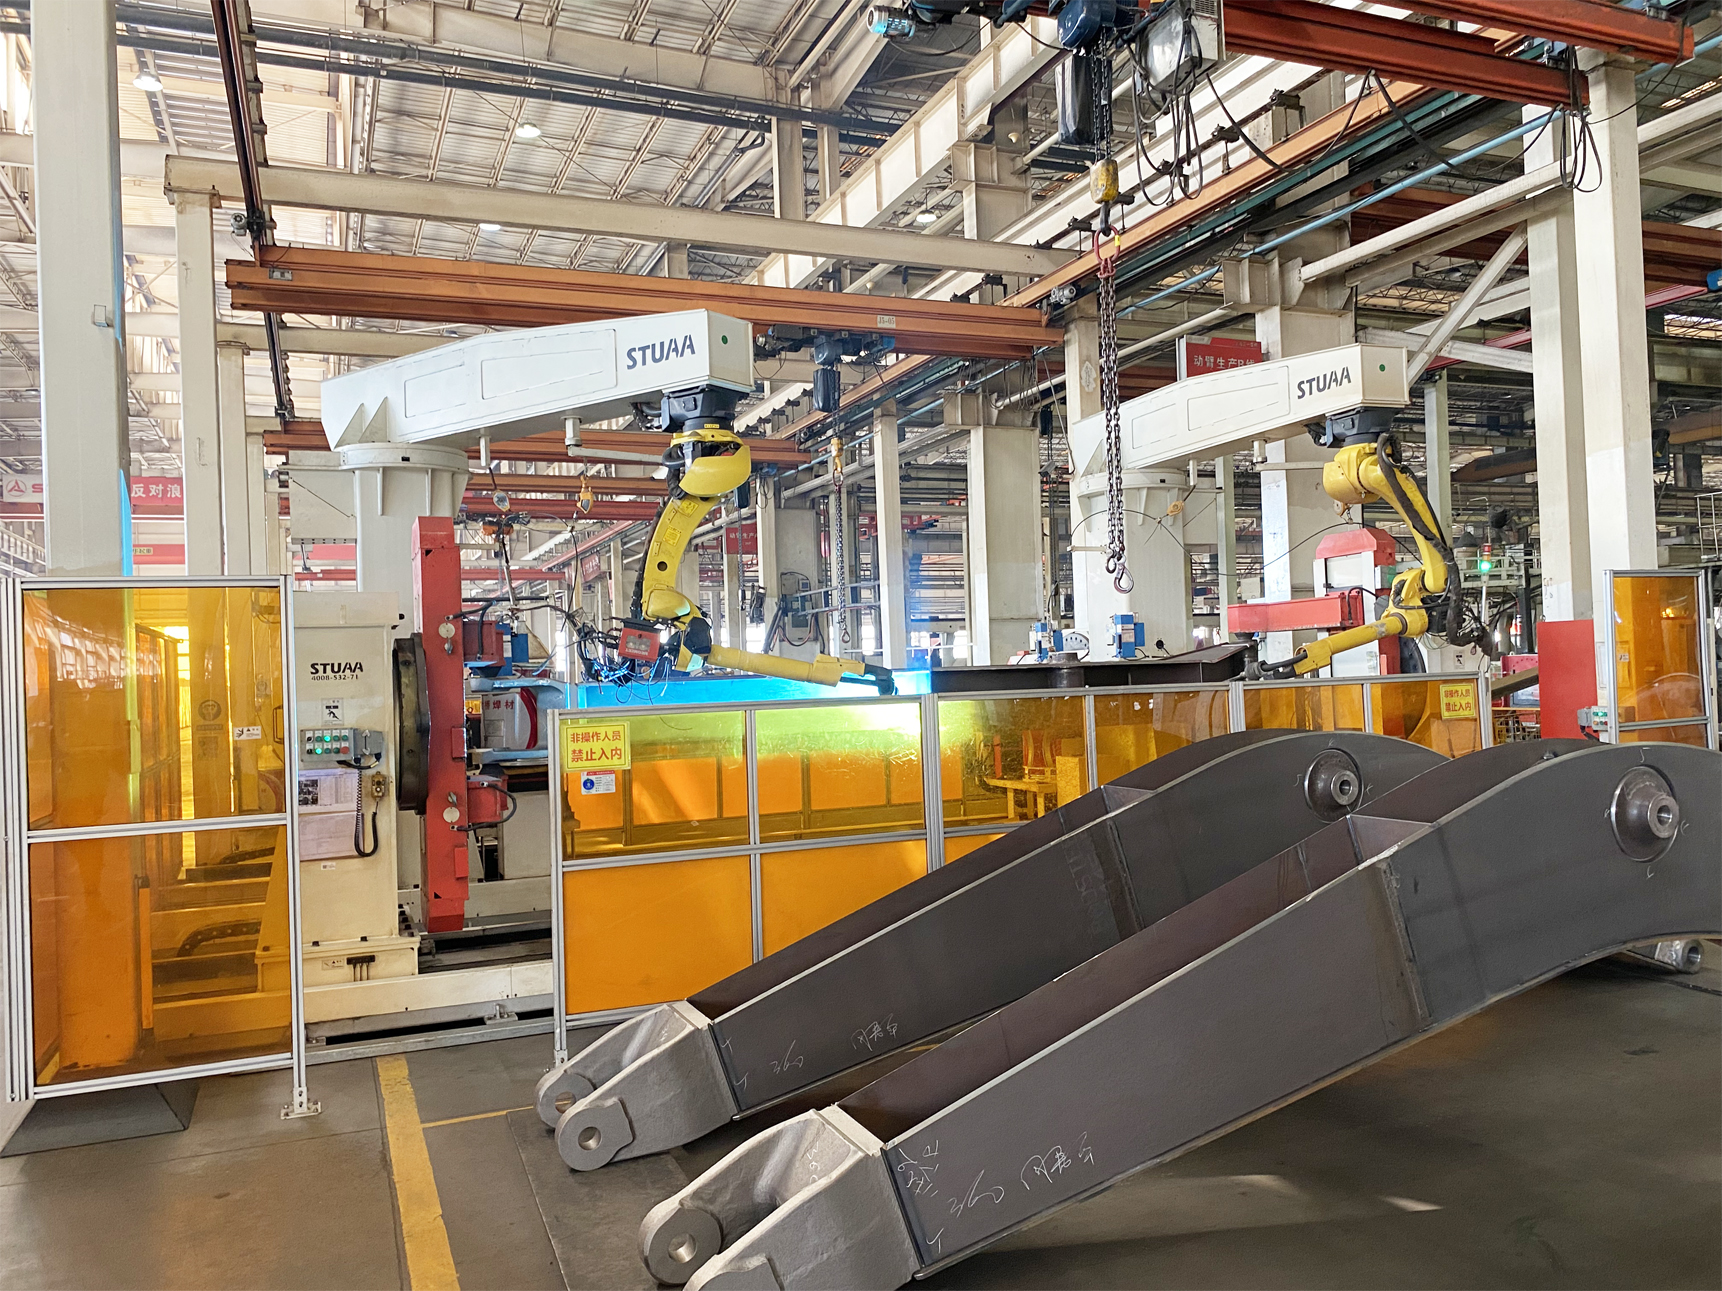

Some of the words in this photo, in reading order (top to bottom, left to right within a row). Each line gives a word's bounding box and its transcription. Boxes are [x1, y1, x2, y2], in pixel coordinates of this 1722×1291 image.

[626, 334, 696, 370] STUAA
[1297, 366, 1352, 400] STUAA
[131, 483, 182, 498] 反对浪
[310, 661, 364, 675] STUAA
[1445, 701, 1472, 712] 禁止入内
[571, 730, 622, 744] 非操作人员
[571, 746, 622, 763] 禁止入内
[947, 1169, 1005, 1218] 360
